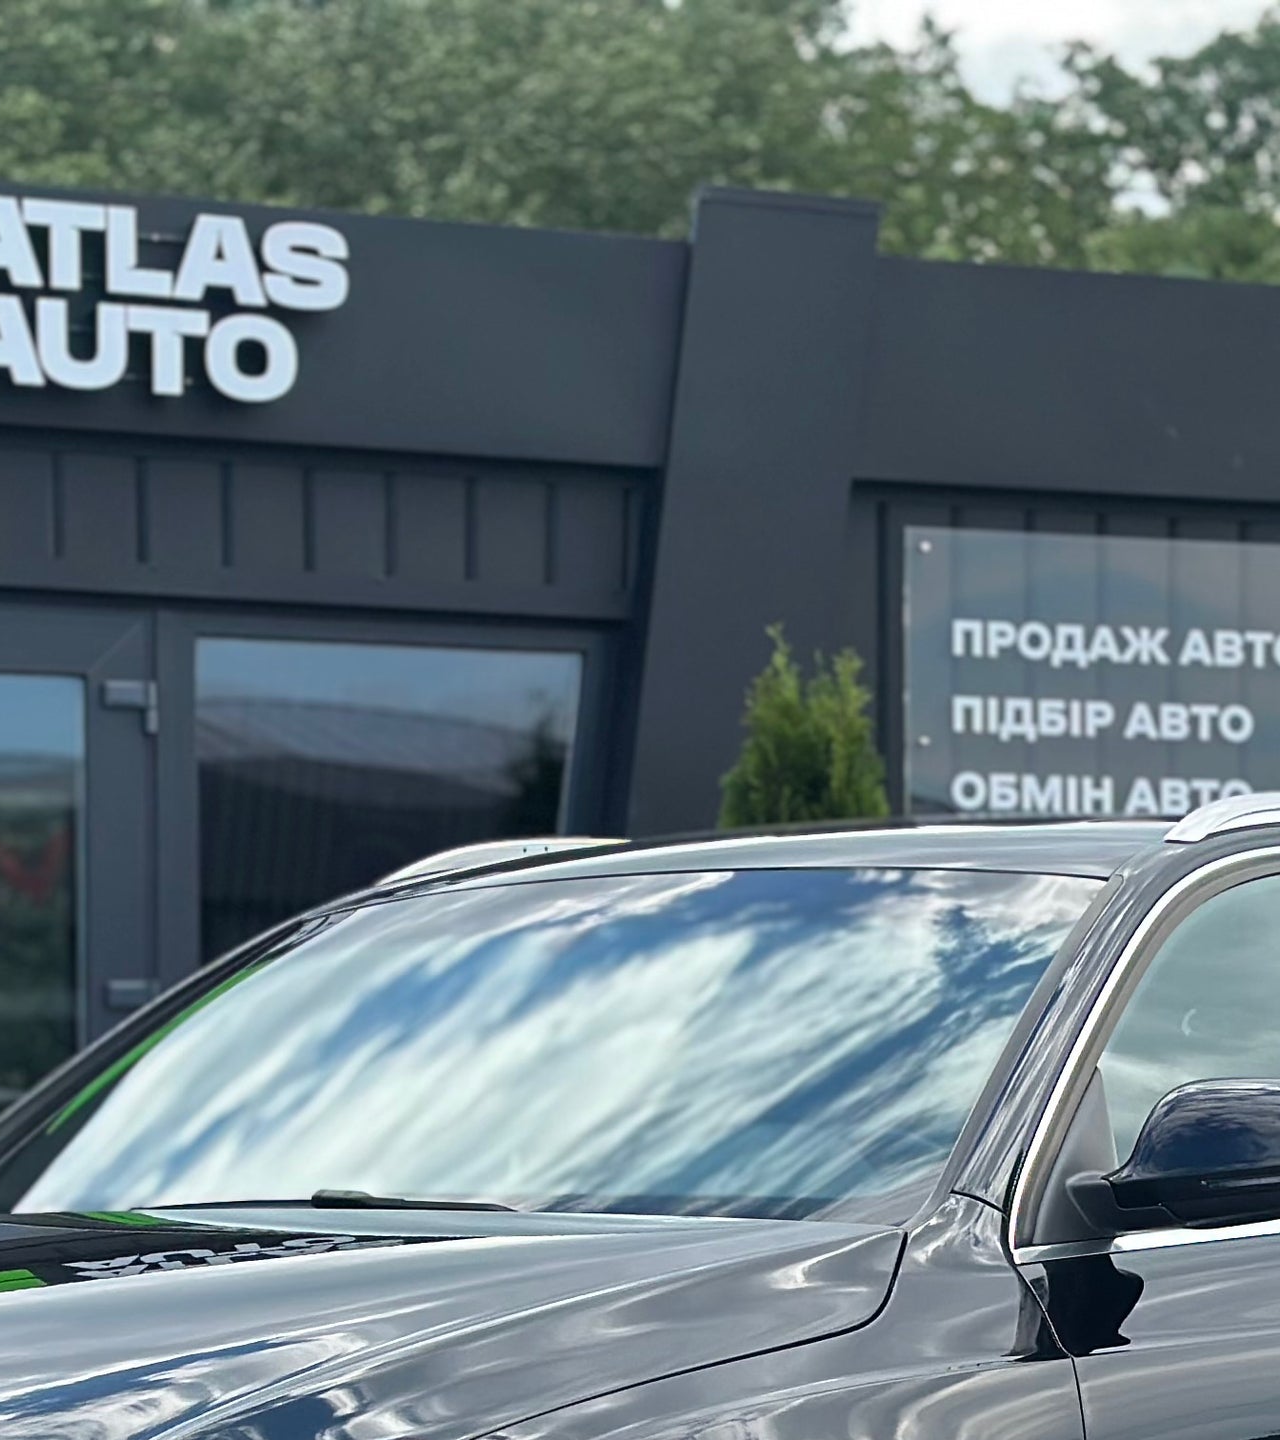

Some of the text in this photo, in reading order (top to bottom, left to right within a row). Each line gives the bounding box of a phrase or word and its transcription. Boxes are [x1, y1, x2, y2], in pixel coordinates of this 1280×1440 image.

[951, 619, 1170, 669] ПРОДАЖ
[951, 695, 1255, 744] ПІДБІР АВТО
[950, 771, 1114, 816] ОБМІН
